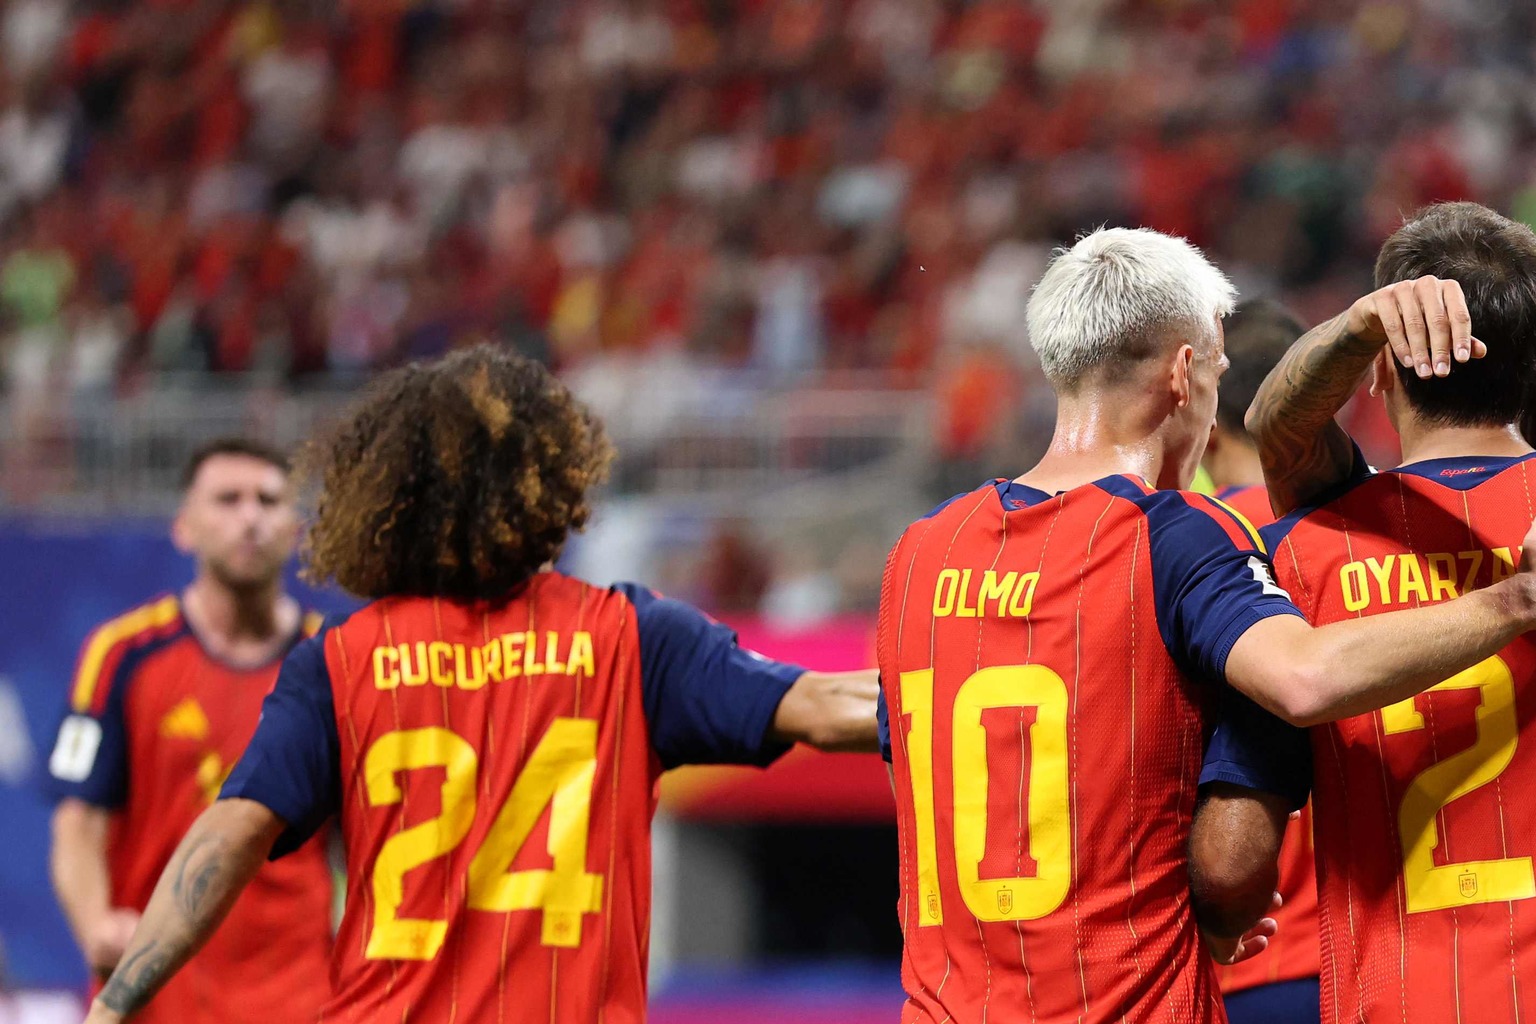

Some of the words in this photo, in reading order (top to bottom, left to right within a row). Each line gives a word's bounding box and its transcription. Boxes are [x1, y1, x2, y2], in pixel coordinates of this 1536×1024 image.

[933, 568, 1041, 618] OLMO
[1339, 546, 1523, 612] OYARZA
[373, 631, 595, 691] CUCURELLA
[900, 664, 1070, 927] 10
[363, 717, 603, 962] 24
